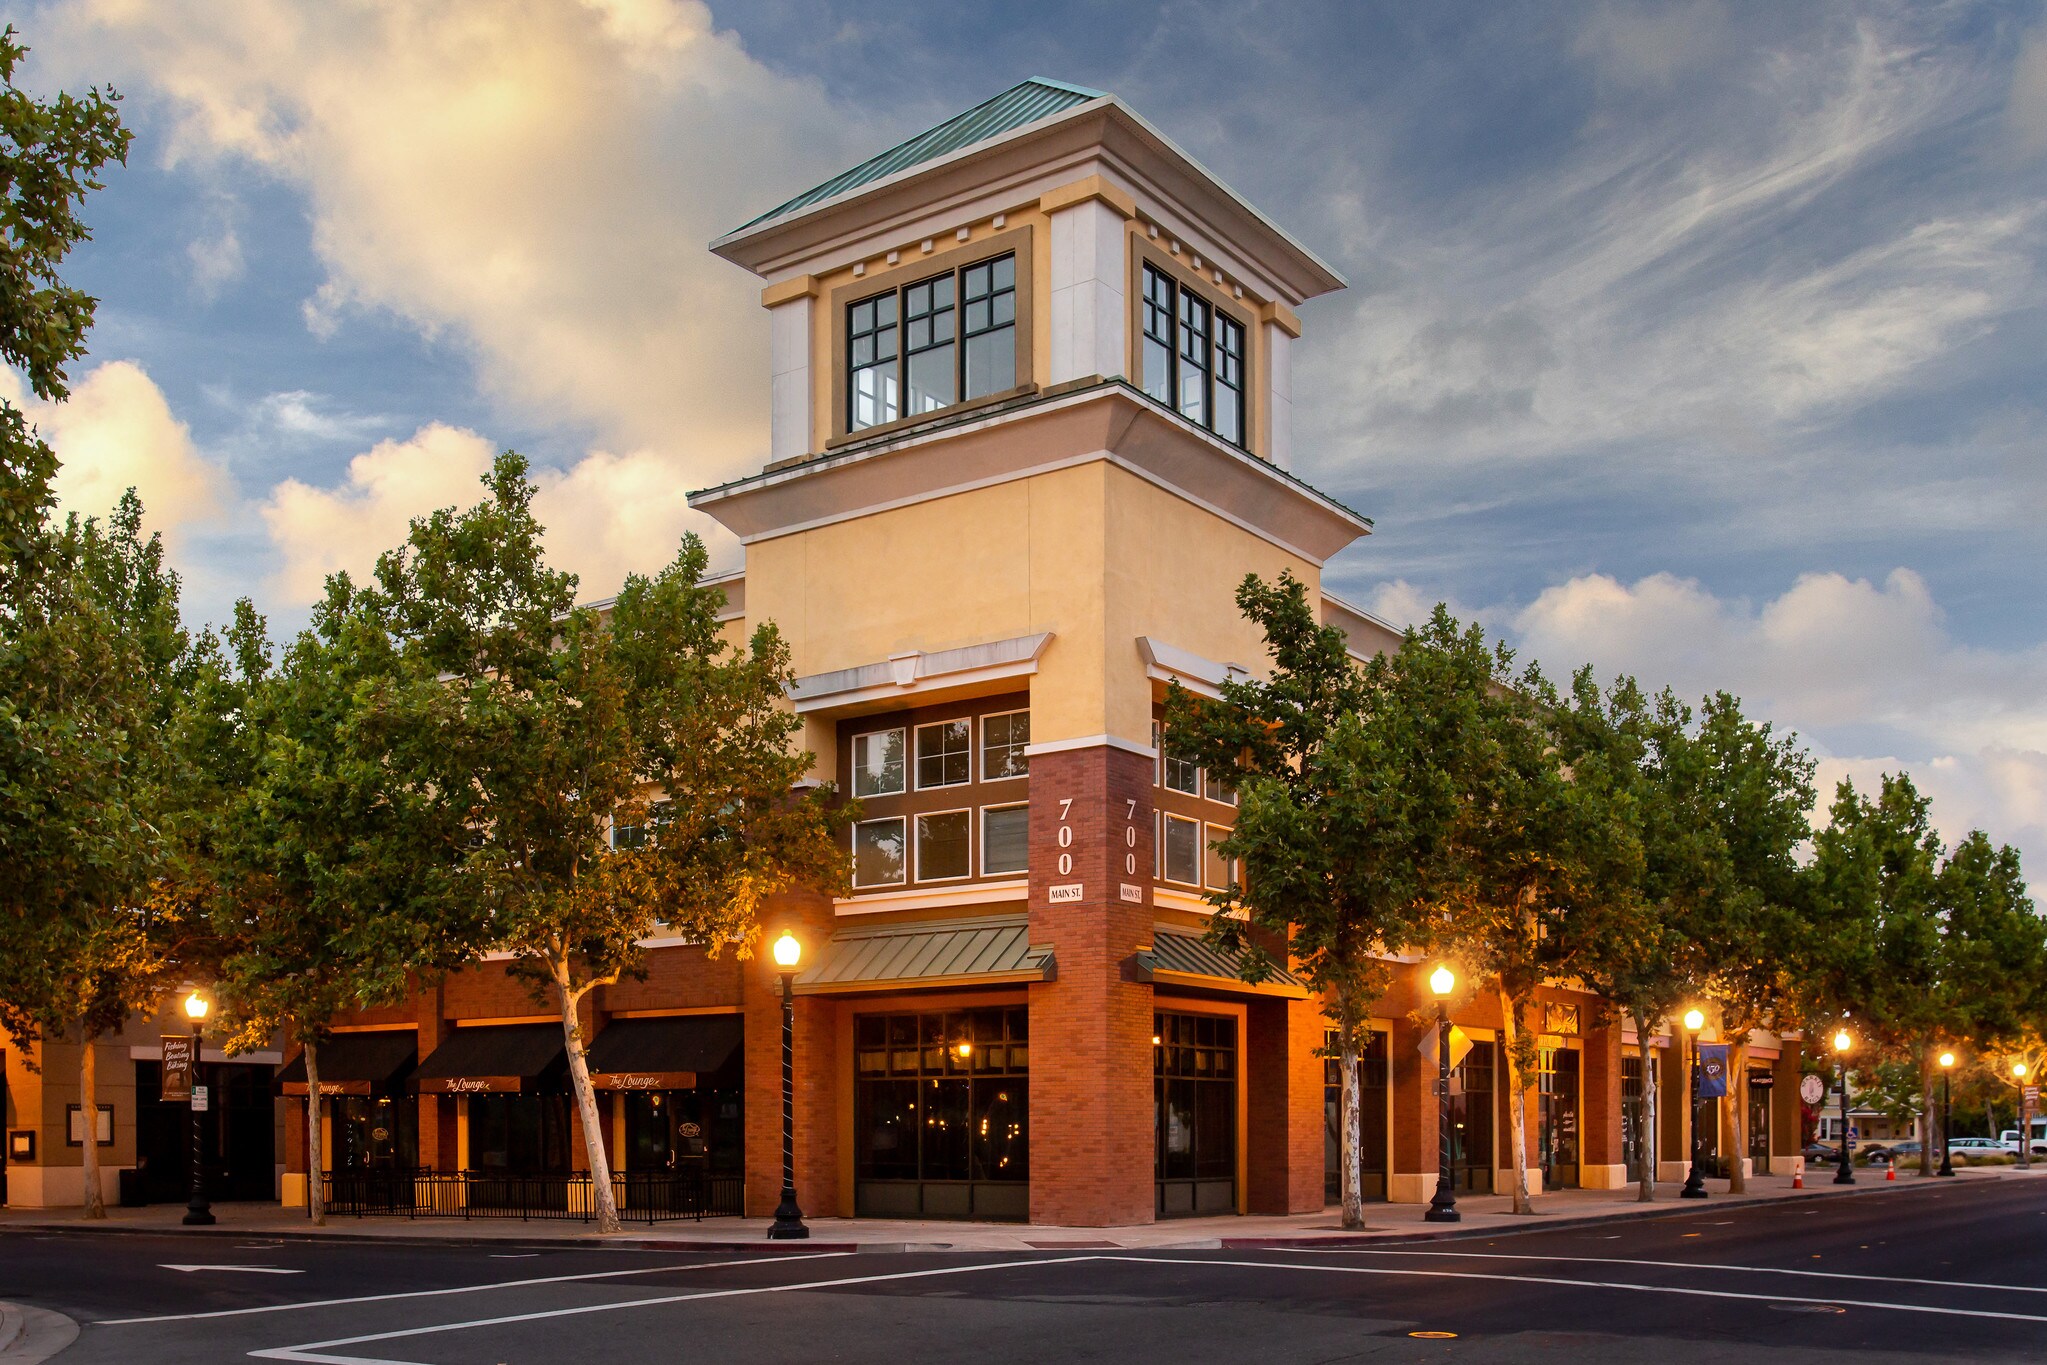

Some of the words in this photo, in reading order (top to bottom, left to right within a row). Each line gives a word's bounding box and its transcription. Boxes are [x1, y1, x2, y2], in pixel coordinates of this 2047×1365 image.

[1058, 798, 1073, 875] 700
[1126, 798, 1136, 875] 700
[1051, 889, 1070, 899] MAIN
[1071, 887, 1081, 898] ST.
[1122, 887, 1134, 898] MAIN
[164, 1041, 188, 1052] Fishing
[165, 1051, 190, 1061] Boating
[1706, 1064, 1720, 1074] 150
[446, 1078, 457, 1089] The
[452, 1077, 485, 1092] Lounge
[609, 1075, 621, 1085] The
[616, 1074, 655, 1089] Lounge
